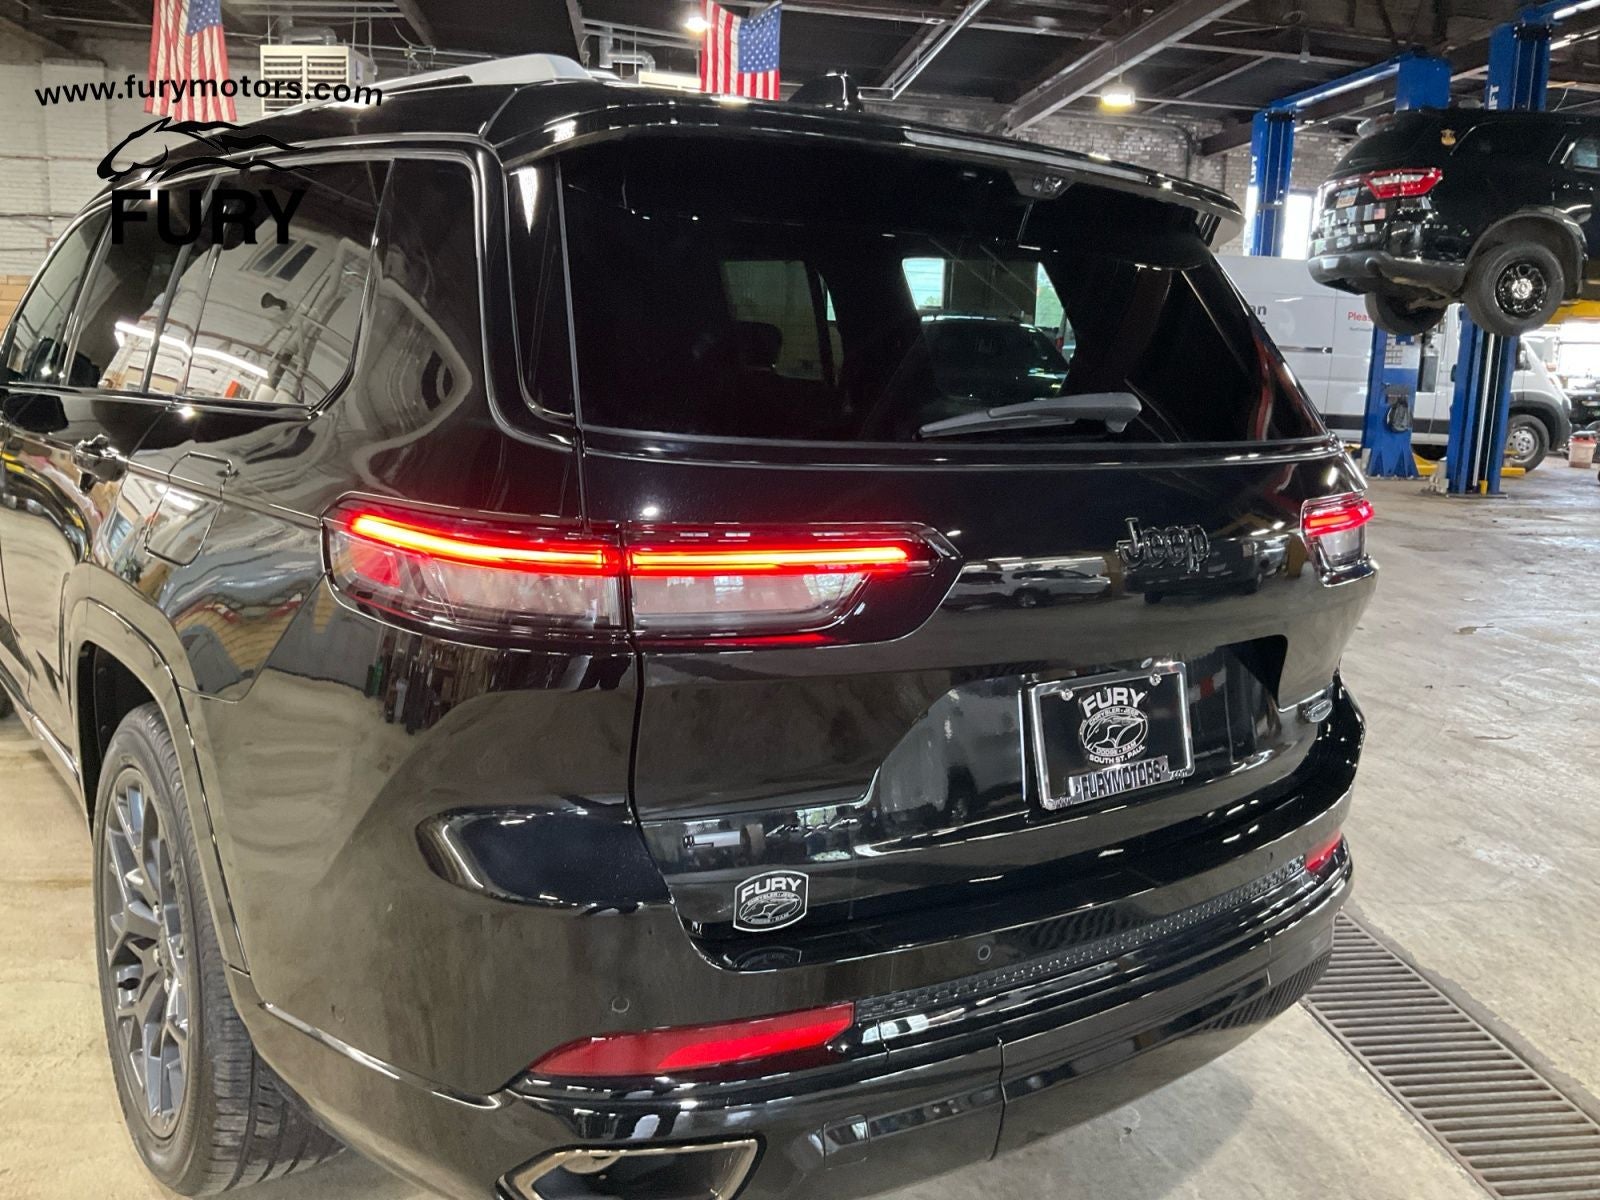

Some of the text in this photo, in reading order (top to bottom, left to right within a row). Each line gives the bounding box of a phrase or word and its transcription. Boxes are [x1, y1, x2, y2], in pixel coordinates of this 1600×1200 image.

[1115, 517, 1210, 574] Jeep
[1082, 687, 1146, 718] FURY
[1088, 754, 1114, 764] SOUTH
[1127, 744, 1146, 759] PAUL
[741, 877, 802, 903] FURY
